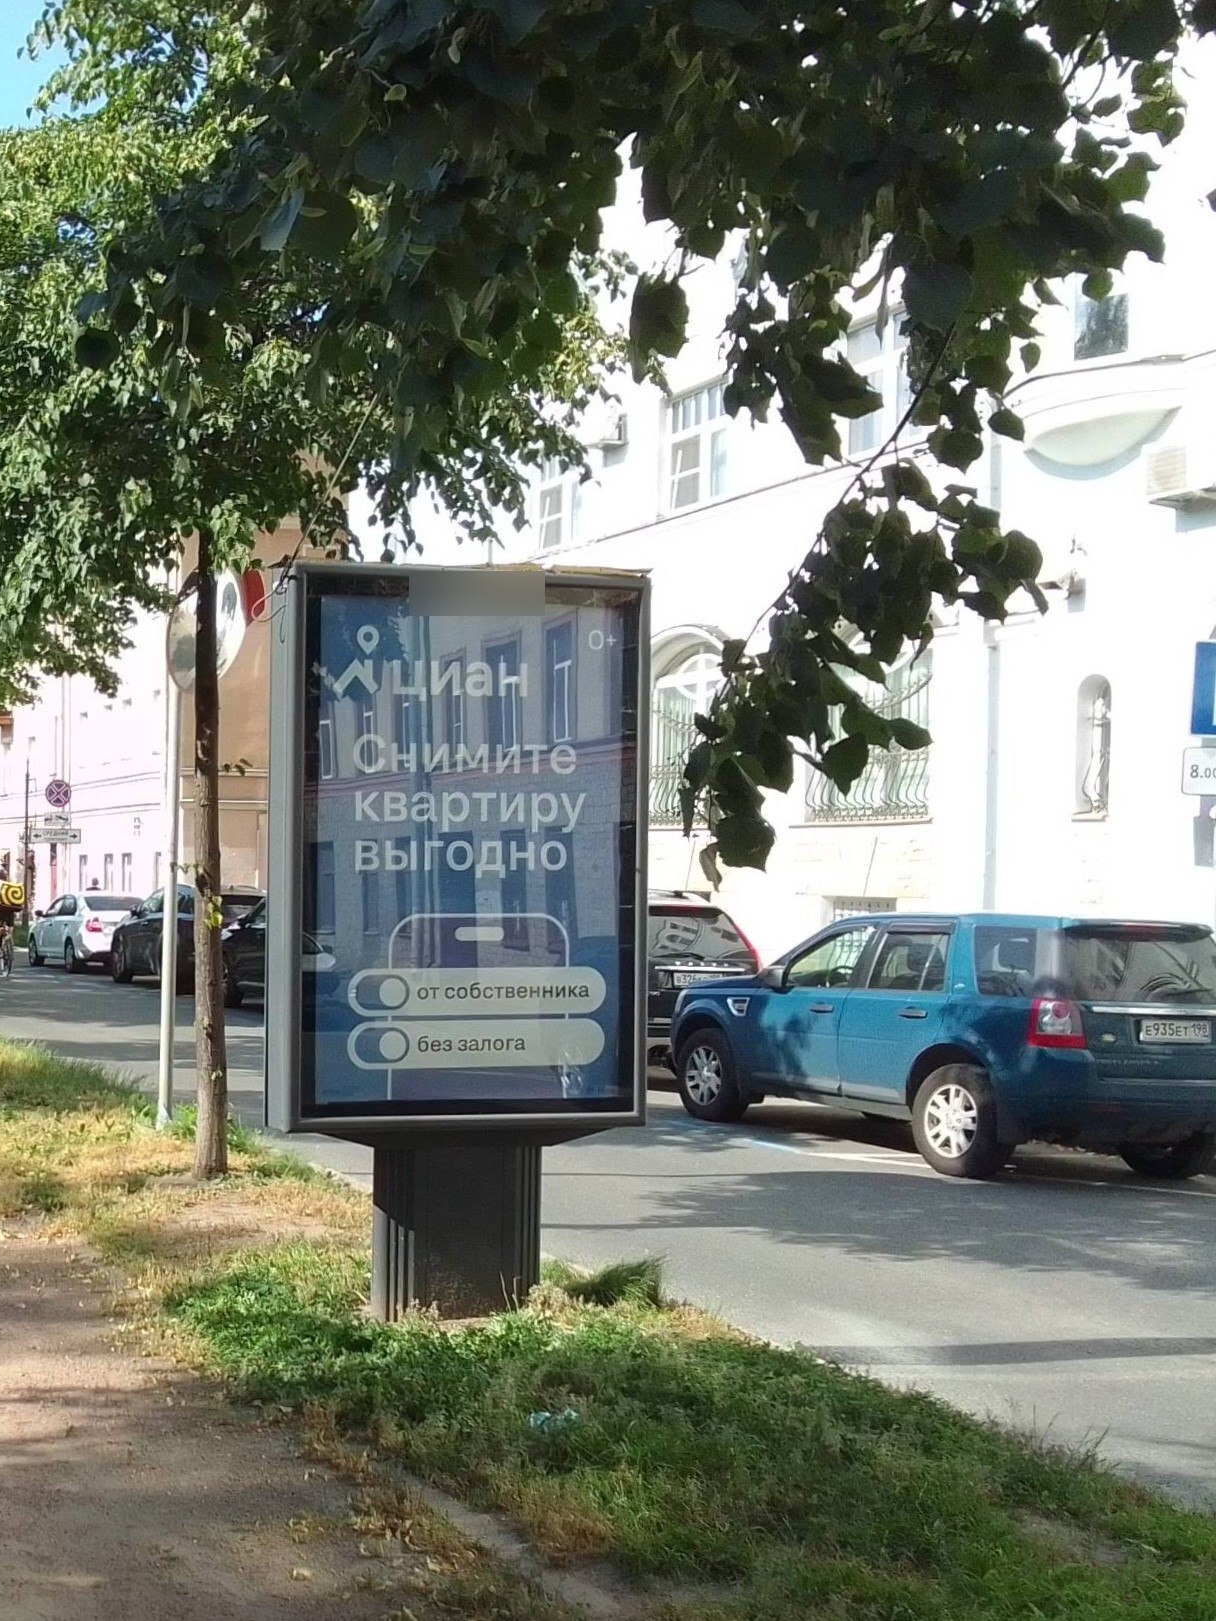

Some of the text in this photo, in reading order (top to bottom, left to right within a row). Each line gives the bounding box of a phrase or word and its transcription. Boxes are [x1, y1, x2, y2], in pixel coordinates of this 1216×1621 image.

[588, 629, 618, 650] 0+
[392, 659, 529, 702] циан
[353, 733, 577, 775] Снимите
[354, 790, 587, 833] квартиру
[354, 839, 568, 879] выгодно
[417, 982, 590, 1000] от собственника
[417, 1035, 526, 1052] без залога
